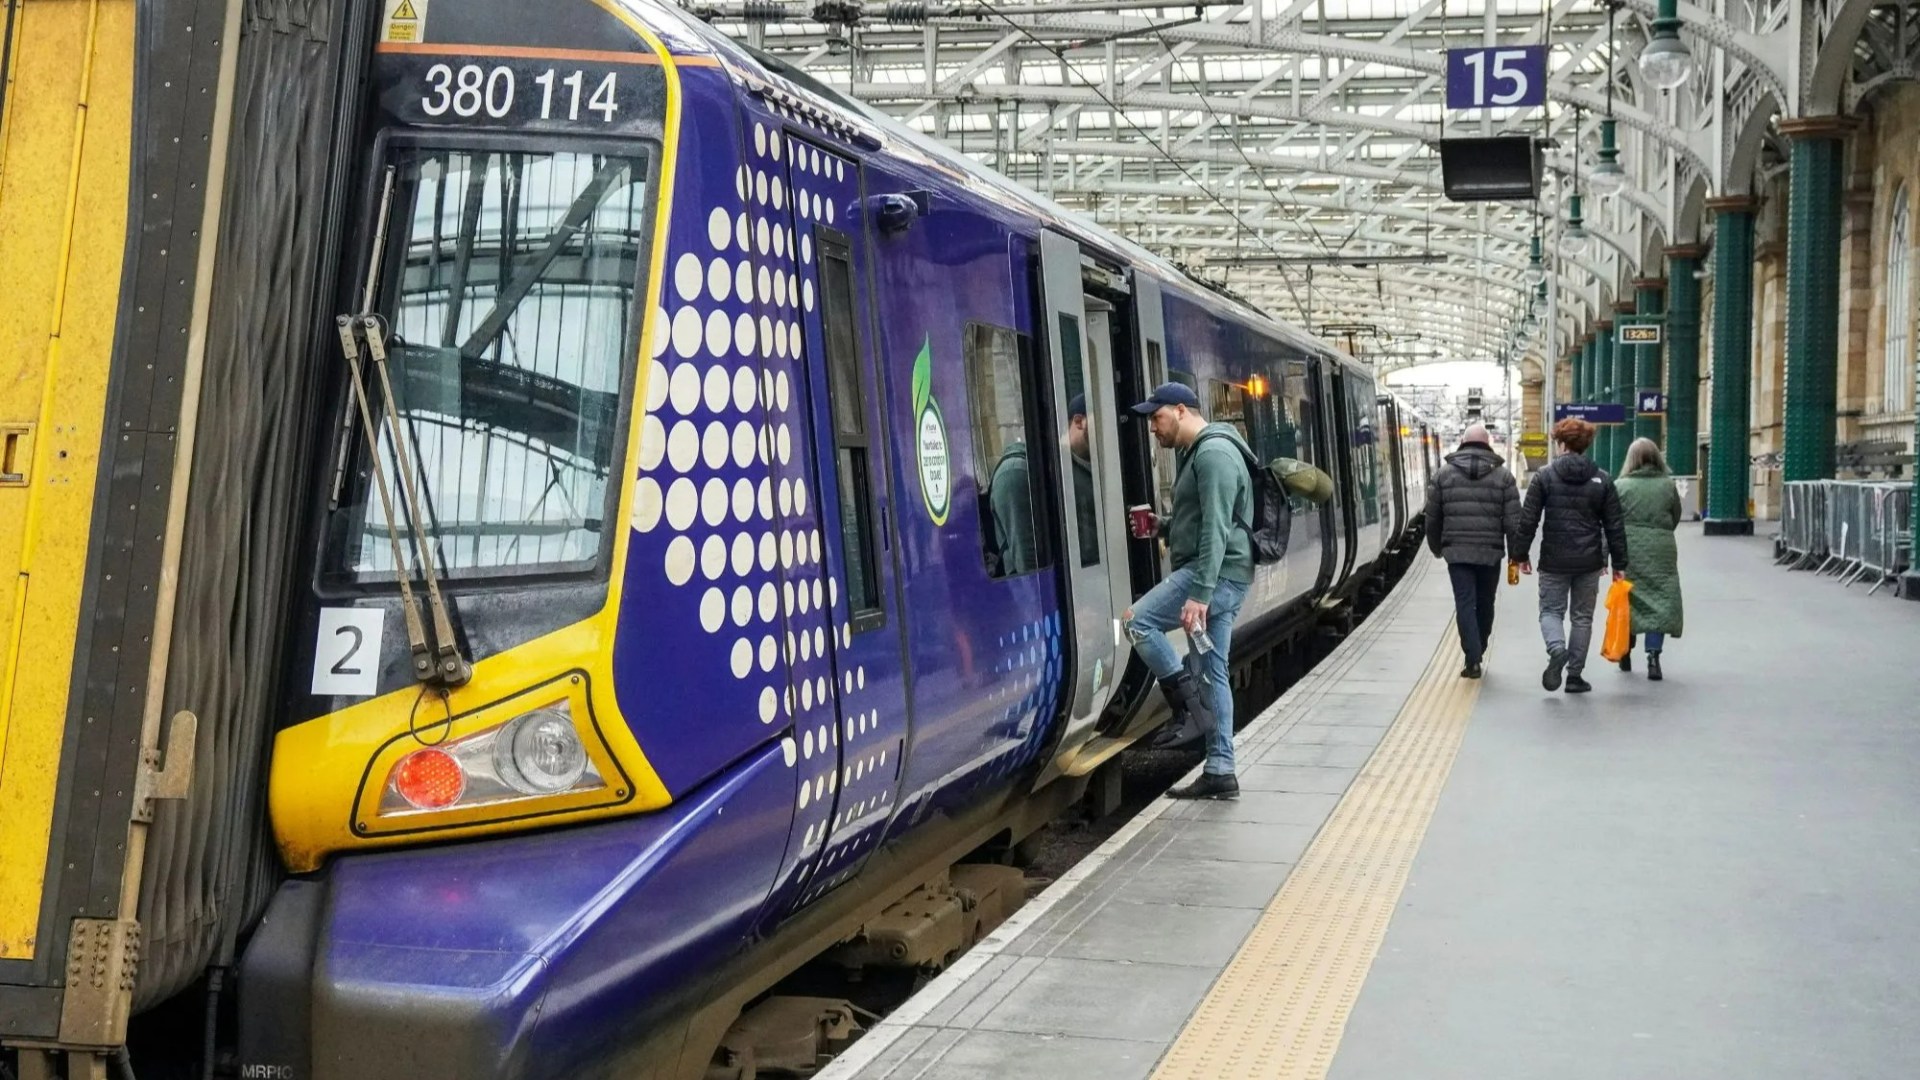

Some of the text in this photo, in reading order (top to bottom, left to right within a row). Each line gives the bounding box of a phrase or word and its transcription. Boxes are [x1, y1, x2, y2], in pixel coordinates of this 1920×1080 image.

[421, 63, 618, 122] 380 114
[1463, 50, 1528, 106] 15
[330, 625, 363, 675] 2
